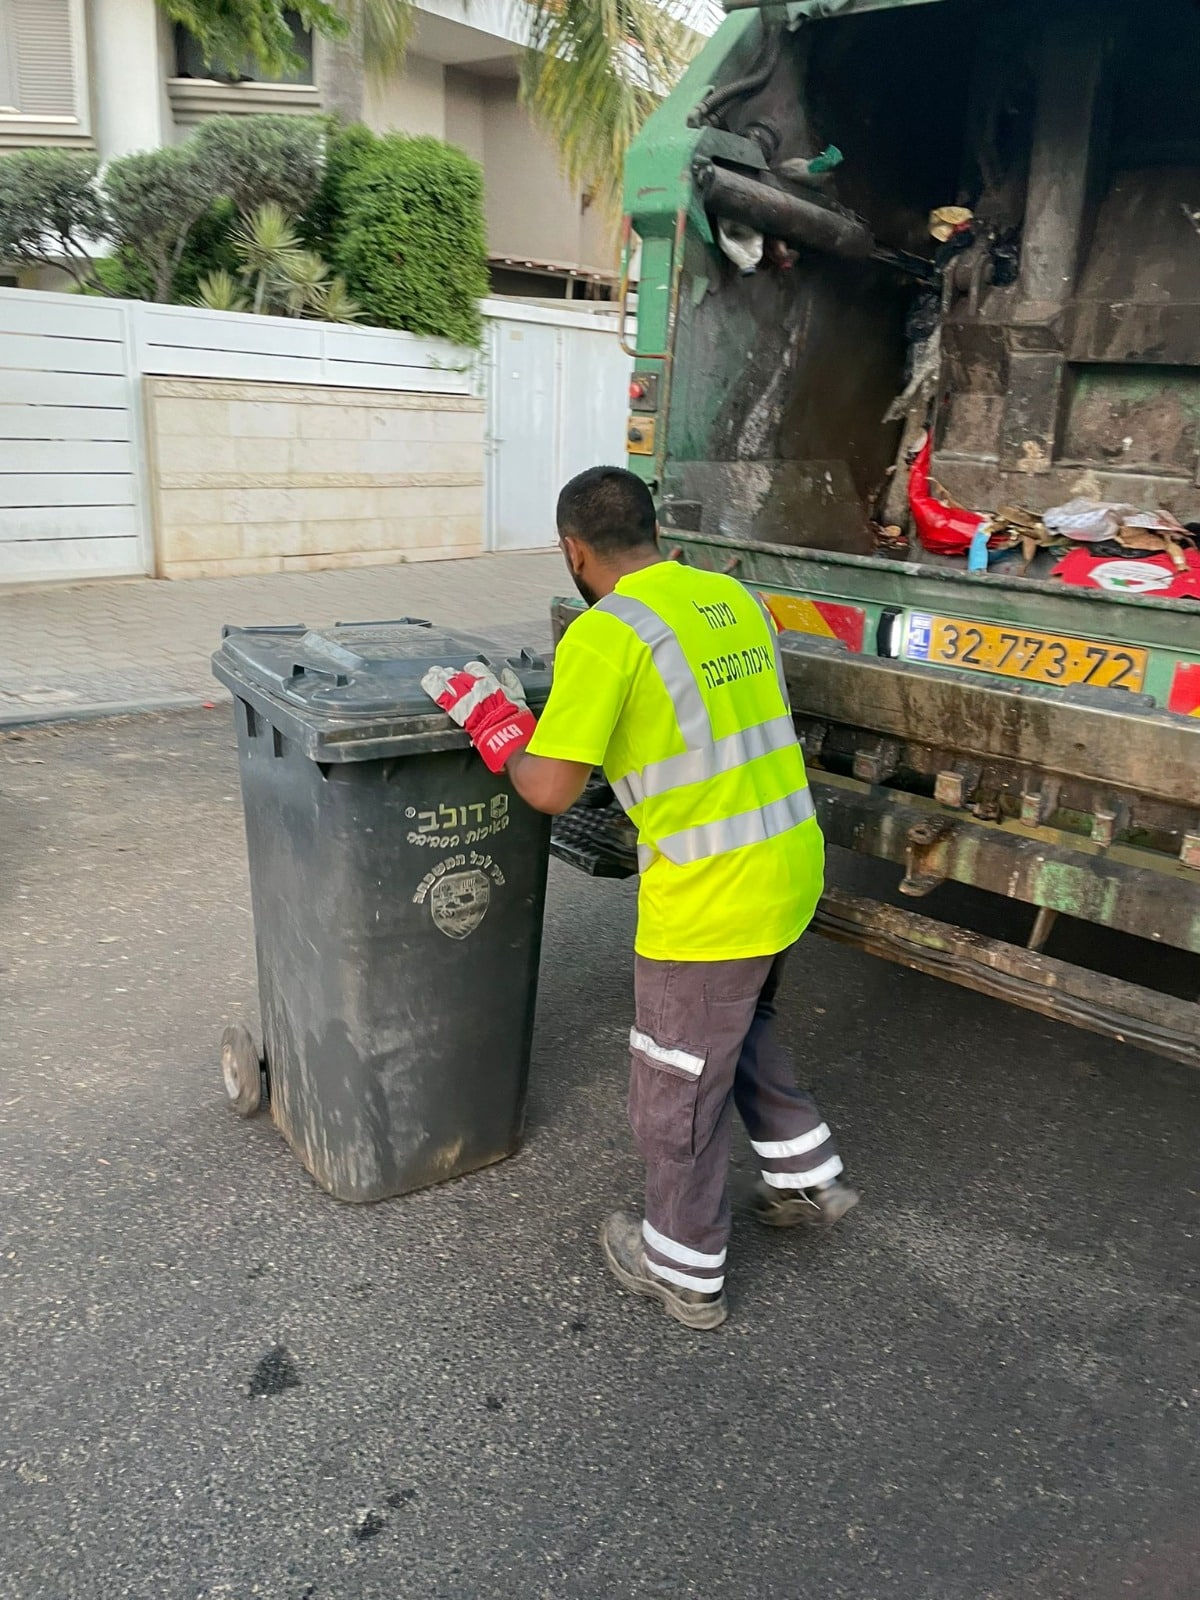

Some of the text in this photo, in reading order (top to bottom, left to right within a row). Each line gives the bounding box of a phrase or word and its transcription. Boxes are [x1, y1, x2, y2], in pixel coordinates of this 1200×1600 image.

[692, 600, 737, 630] מינהל
[701, 645, 774, 689] איכות הסביבה
[417, 801, 486, 833] דולב
